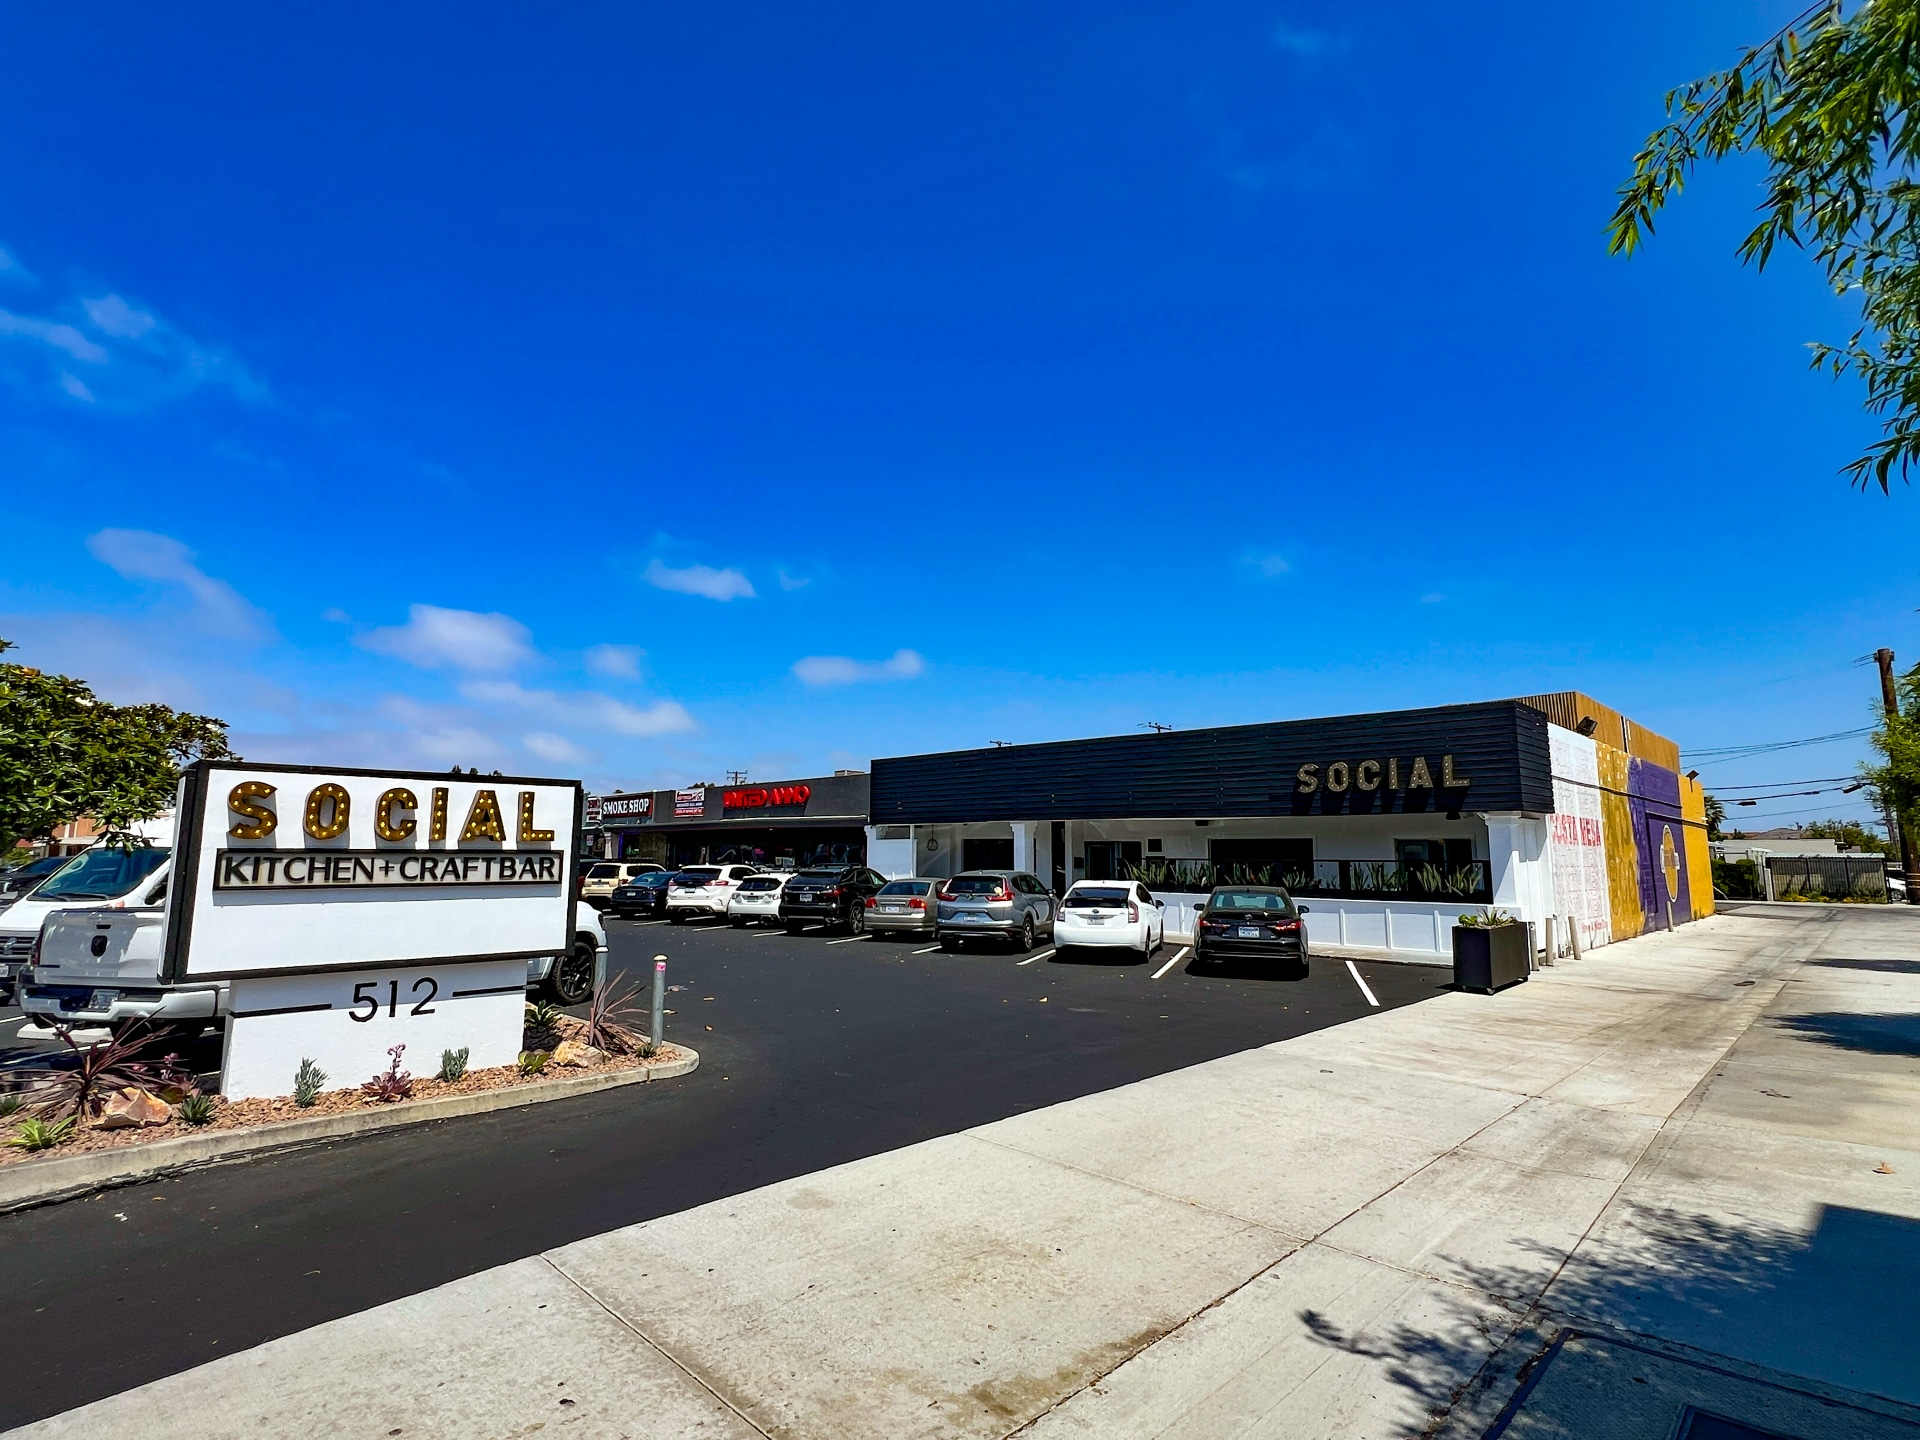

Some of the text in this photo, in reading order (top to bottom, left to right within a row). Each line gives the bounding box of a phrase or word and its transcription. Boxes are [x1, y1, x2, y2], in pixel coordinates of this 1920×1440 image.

[1297, 755, 1470, 793] SOCIAL
[229, 781, 554, 841] SOCIAL
[603, 800, 628, 814] SMOKE
[629, 798, 649, 813] SHOP
[770, 785, 810, 805] AMMO
[1550, 813, 1601, 847] COSTA MESA
[349, 977, 439, 1022] 512
